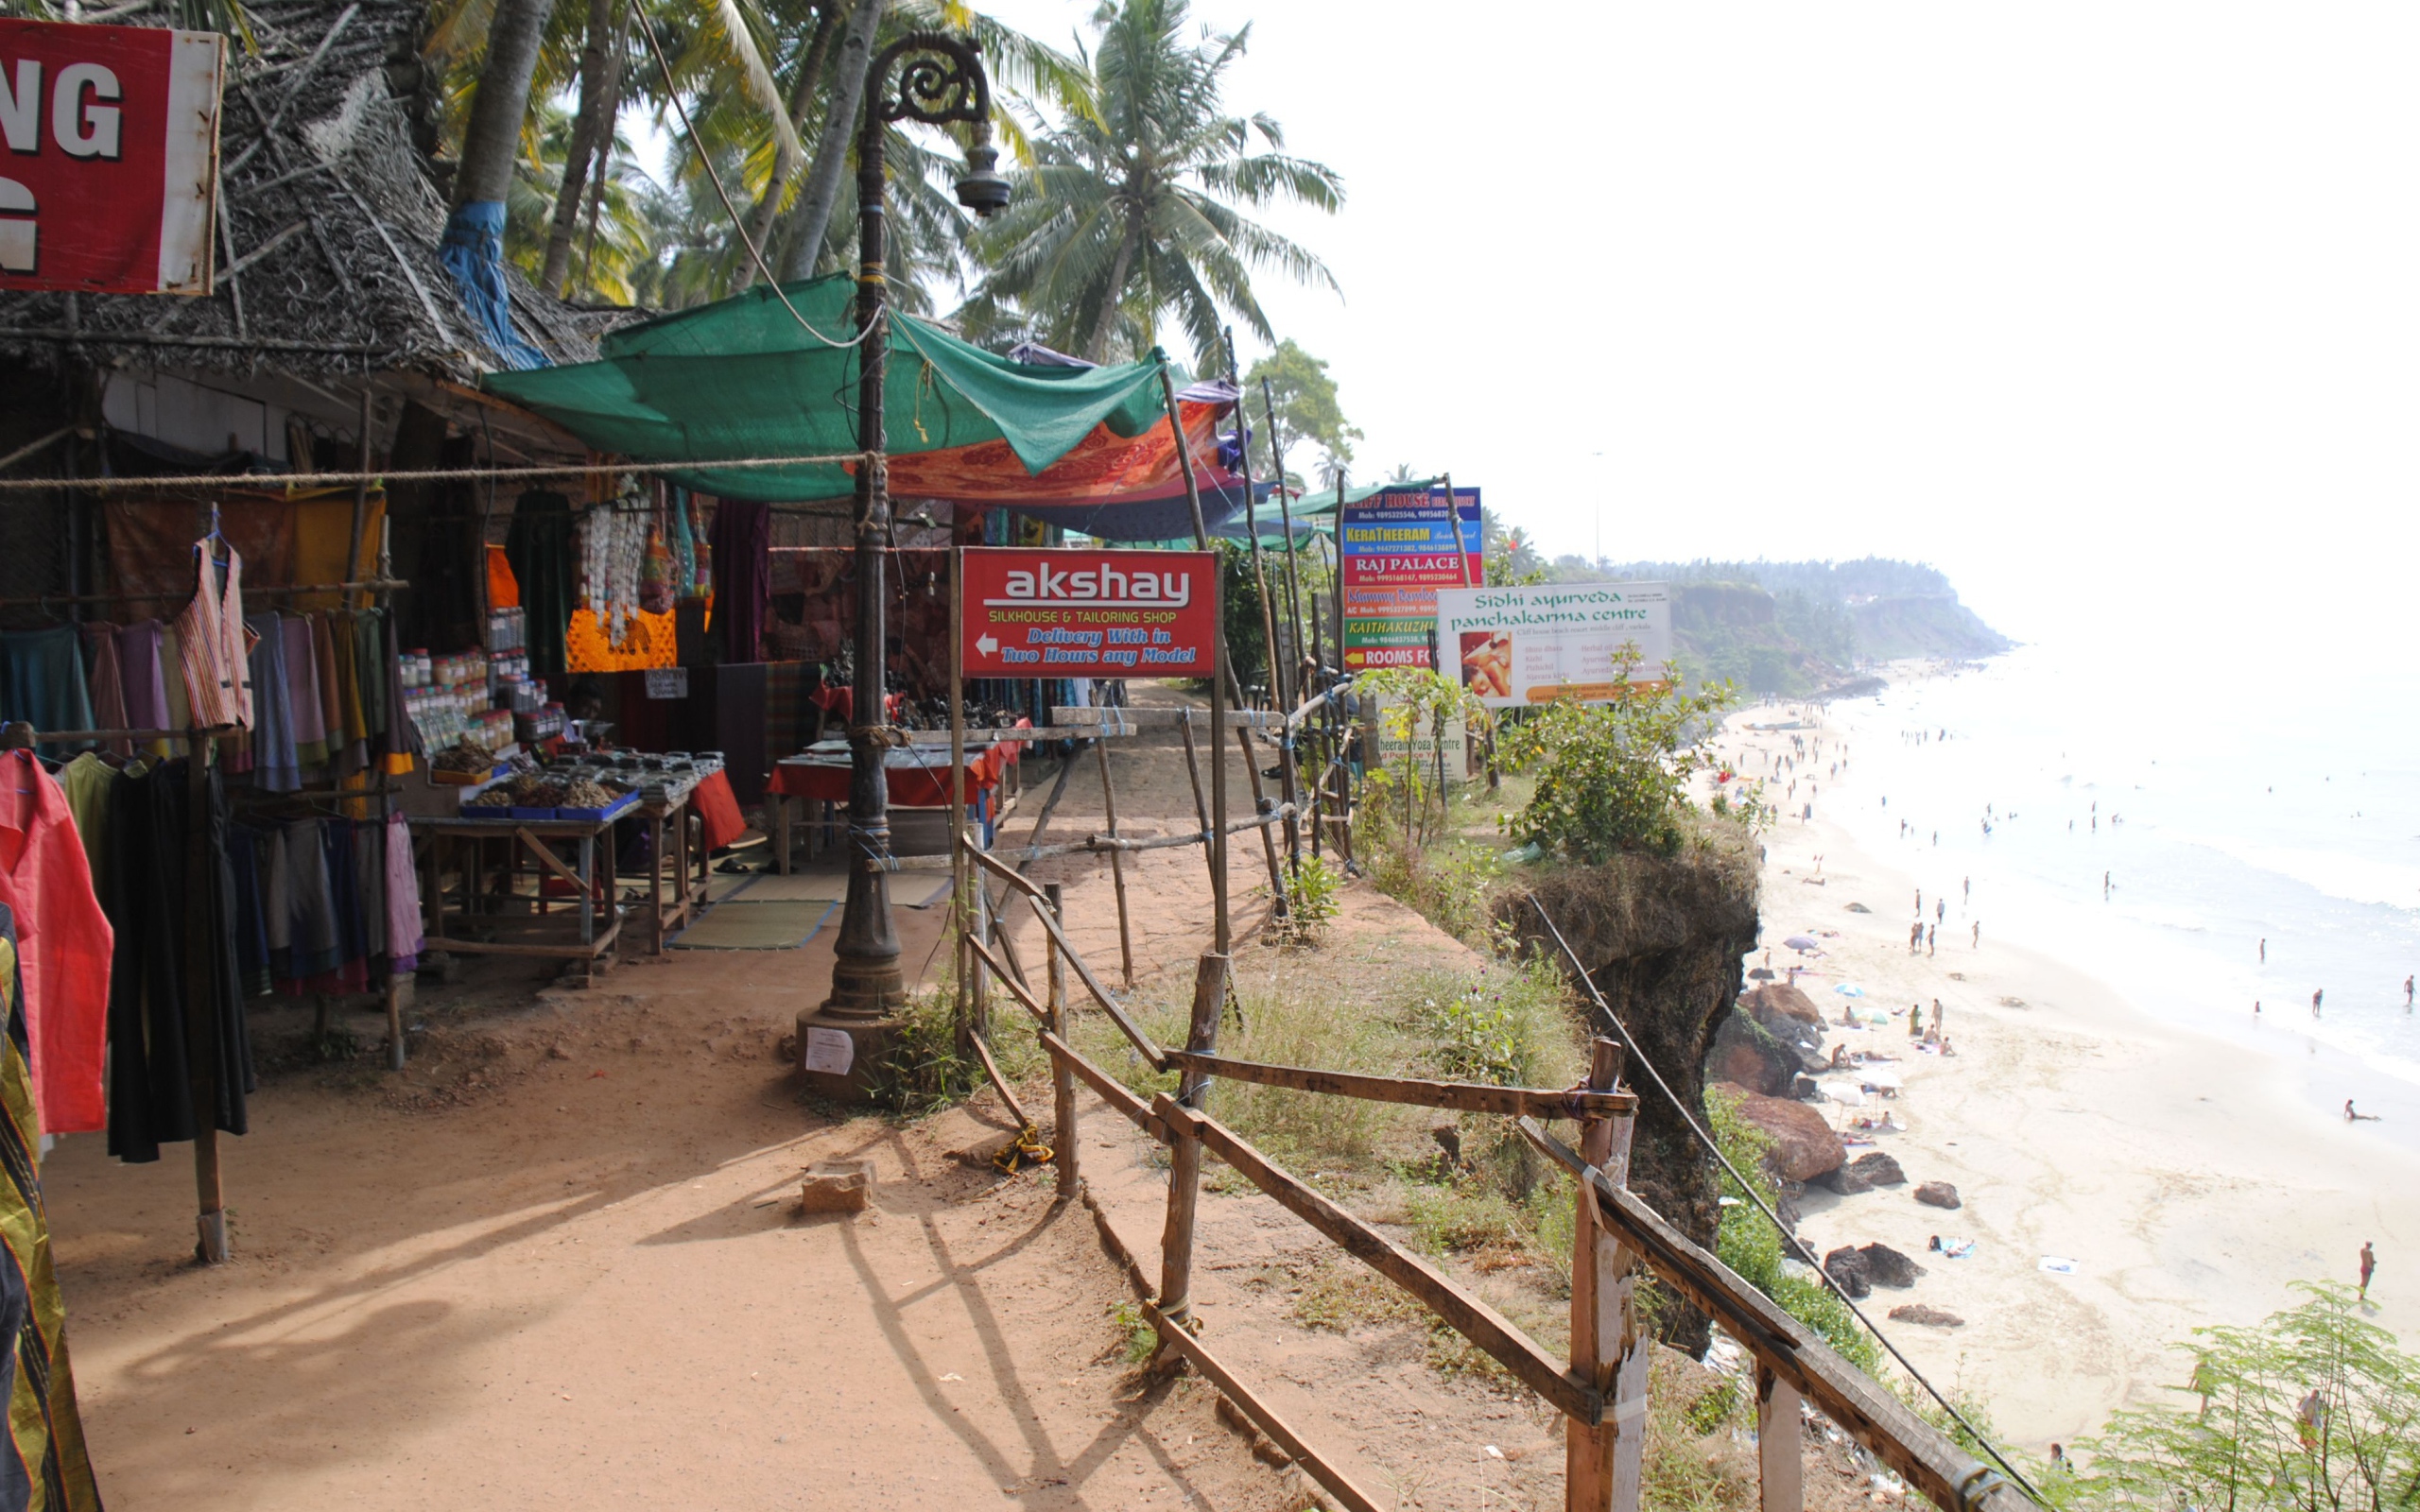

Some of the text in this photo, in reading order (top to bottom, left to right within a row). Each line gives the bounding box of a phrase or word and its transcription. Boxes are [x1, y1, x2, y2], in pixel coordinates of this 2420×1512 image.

[1385, 493, 1429, 508] HOUSE
[1432, 496, 1450, 507] BEAC
[1454, 495, 1476, 507] ESORT
[1356, 558, 1460, 573] RAJ PALACE
[1004, 562, 1189, 607] akshay
[1348, 589, 1395, 606] Mummy
[1475, 591, 1621, 610] Sidhi ayurveda
[989, 610, 1177, 624] SILKHOUSE & TAILORING SHOP
[1450, 608, 1647, 631] panchakarma centre
[1349, 621, 1434, 633] KAITHAKUZHI
[1027, 627, 1171, 645] Delivery With in
[1002, 646, 1196, 667] Two Hours any Model
[1366, 650, 1413, 664] ROOMS
[1412, 739, 1431, 751] Yoga
